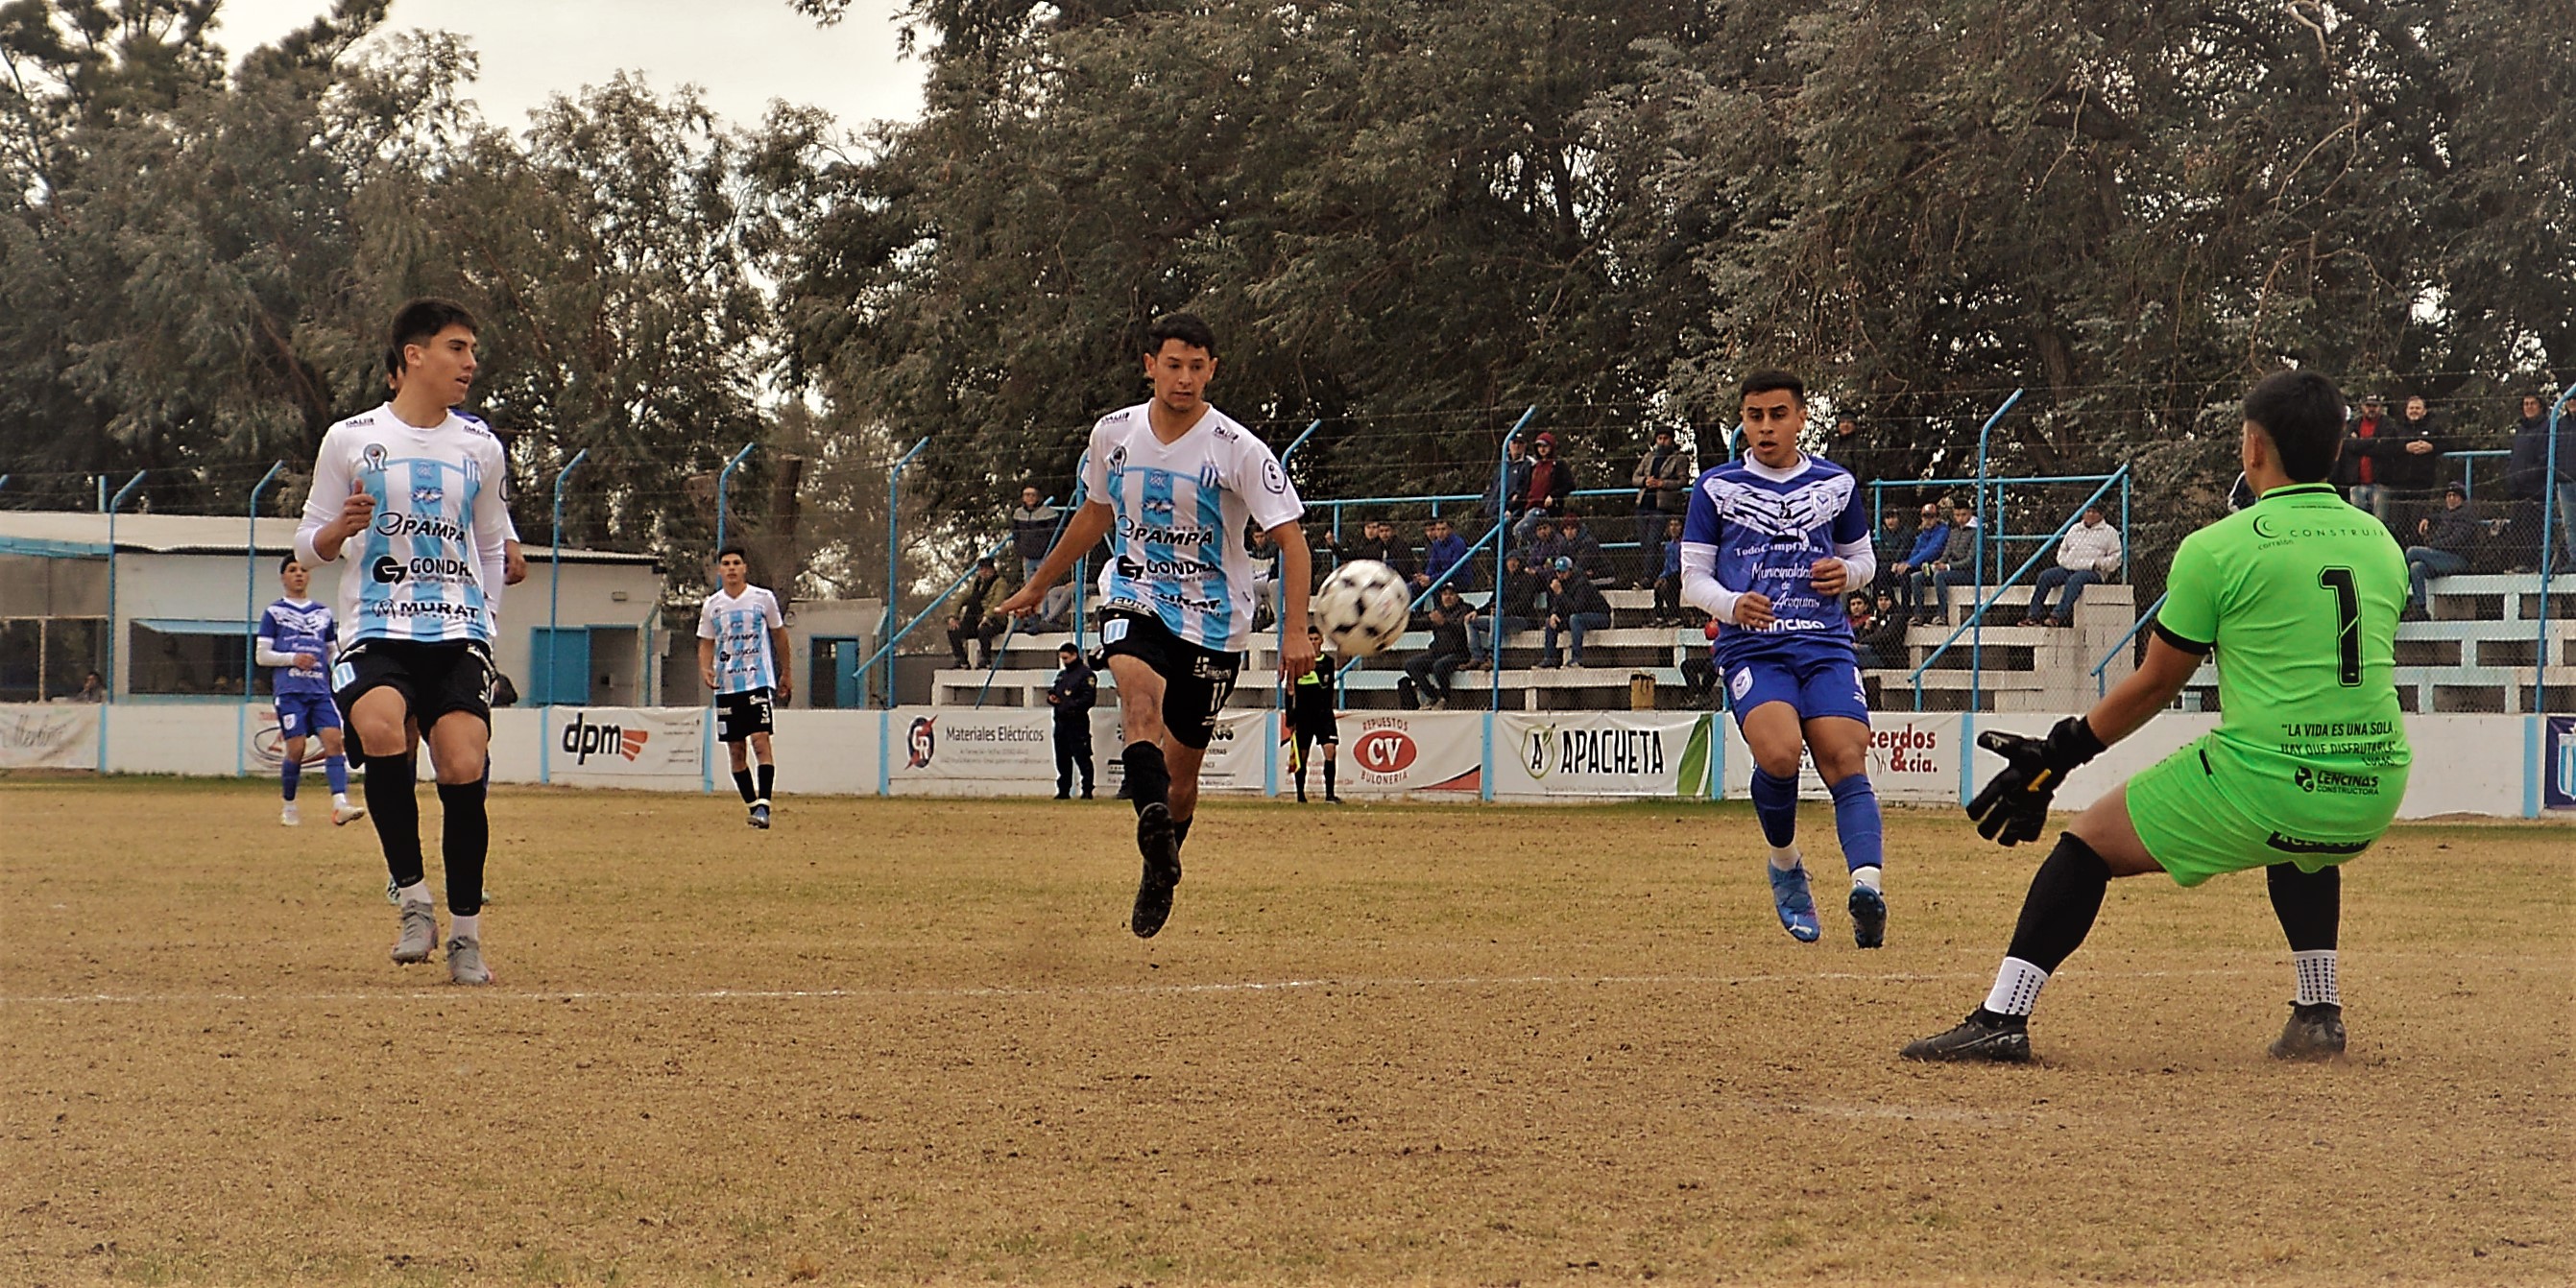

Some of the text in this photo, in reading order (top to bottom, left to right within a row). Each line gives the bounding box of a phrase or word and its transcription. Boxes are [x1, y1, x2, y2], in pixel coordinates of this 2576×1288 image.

[401, 519, 465, 542] PAMPA
[1134, 527, 1213, 547] PAMPA
[410, 558, 473, 578] GONDR
[1781, 582, 1791, 590] de
[400, 603, 478, 618] MURAT
[2317, 565, 2363, 687] 1
[760, 704, 769, 717] 3
[1362, 717, 1408, 730] REPUESTOS
[2304, 724, 2328, 736] VIDA
[2332, 723, 2345, 736] ES
[2347, 723, 2368, 736] UNA
[563, 712, 620, 765] dpm
[946, 725, 1044, 741] Materiales Eléctricos
[1367, 737, 1403, 766] CV
[1560, 730, 1664, 775] APACHETA
[2305, 743, 2327, 755] QUE
[1910, 752, 1938, 773] cia.
[2317, 770, 2379, 787] LENCINAS
[2316, 785, 2379, 796] CONSTRUCTORA
